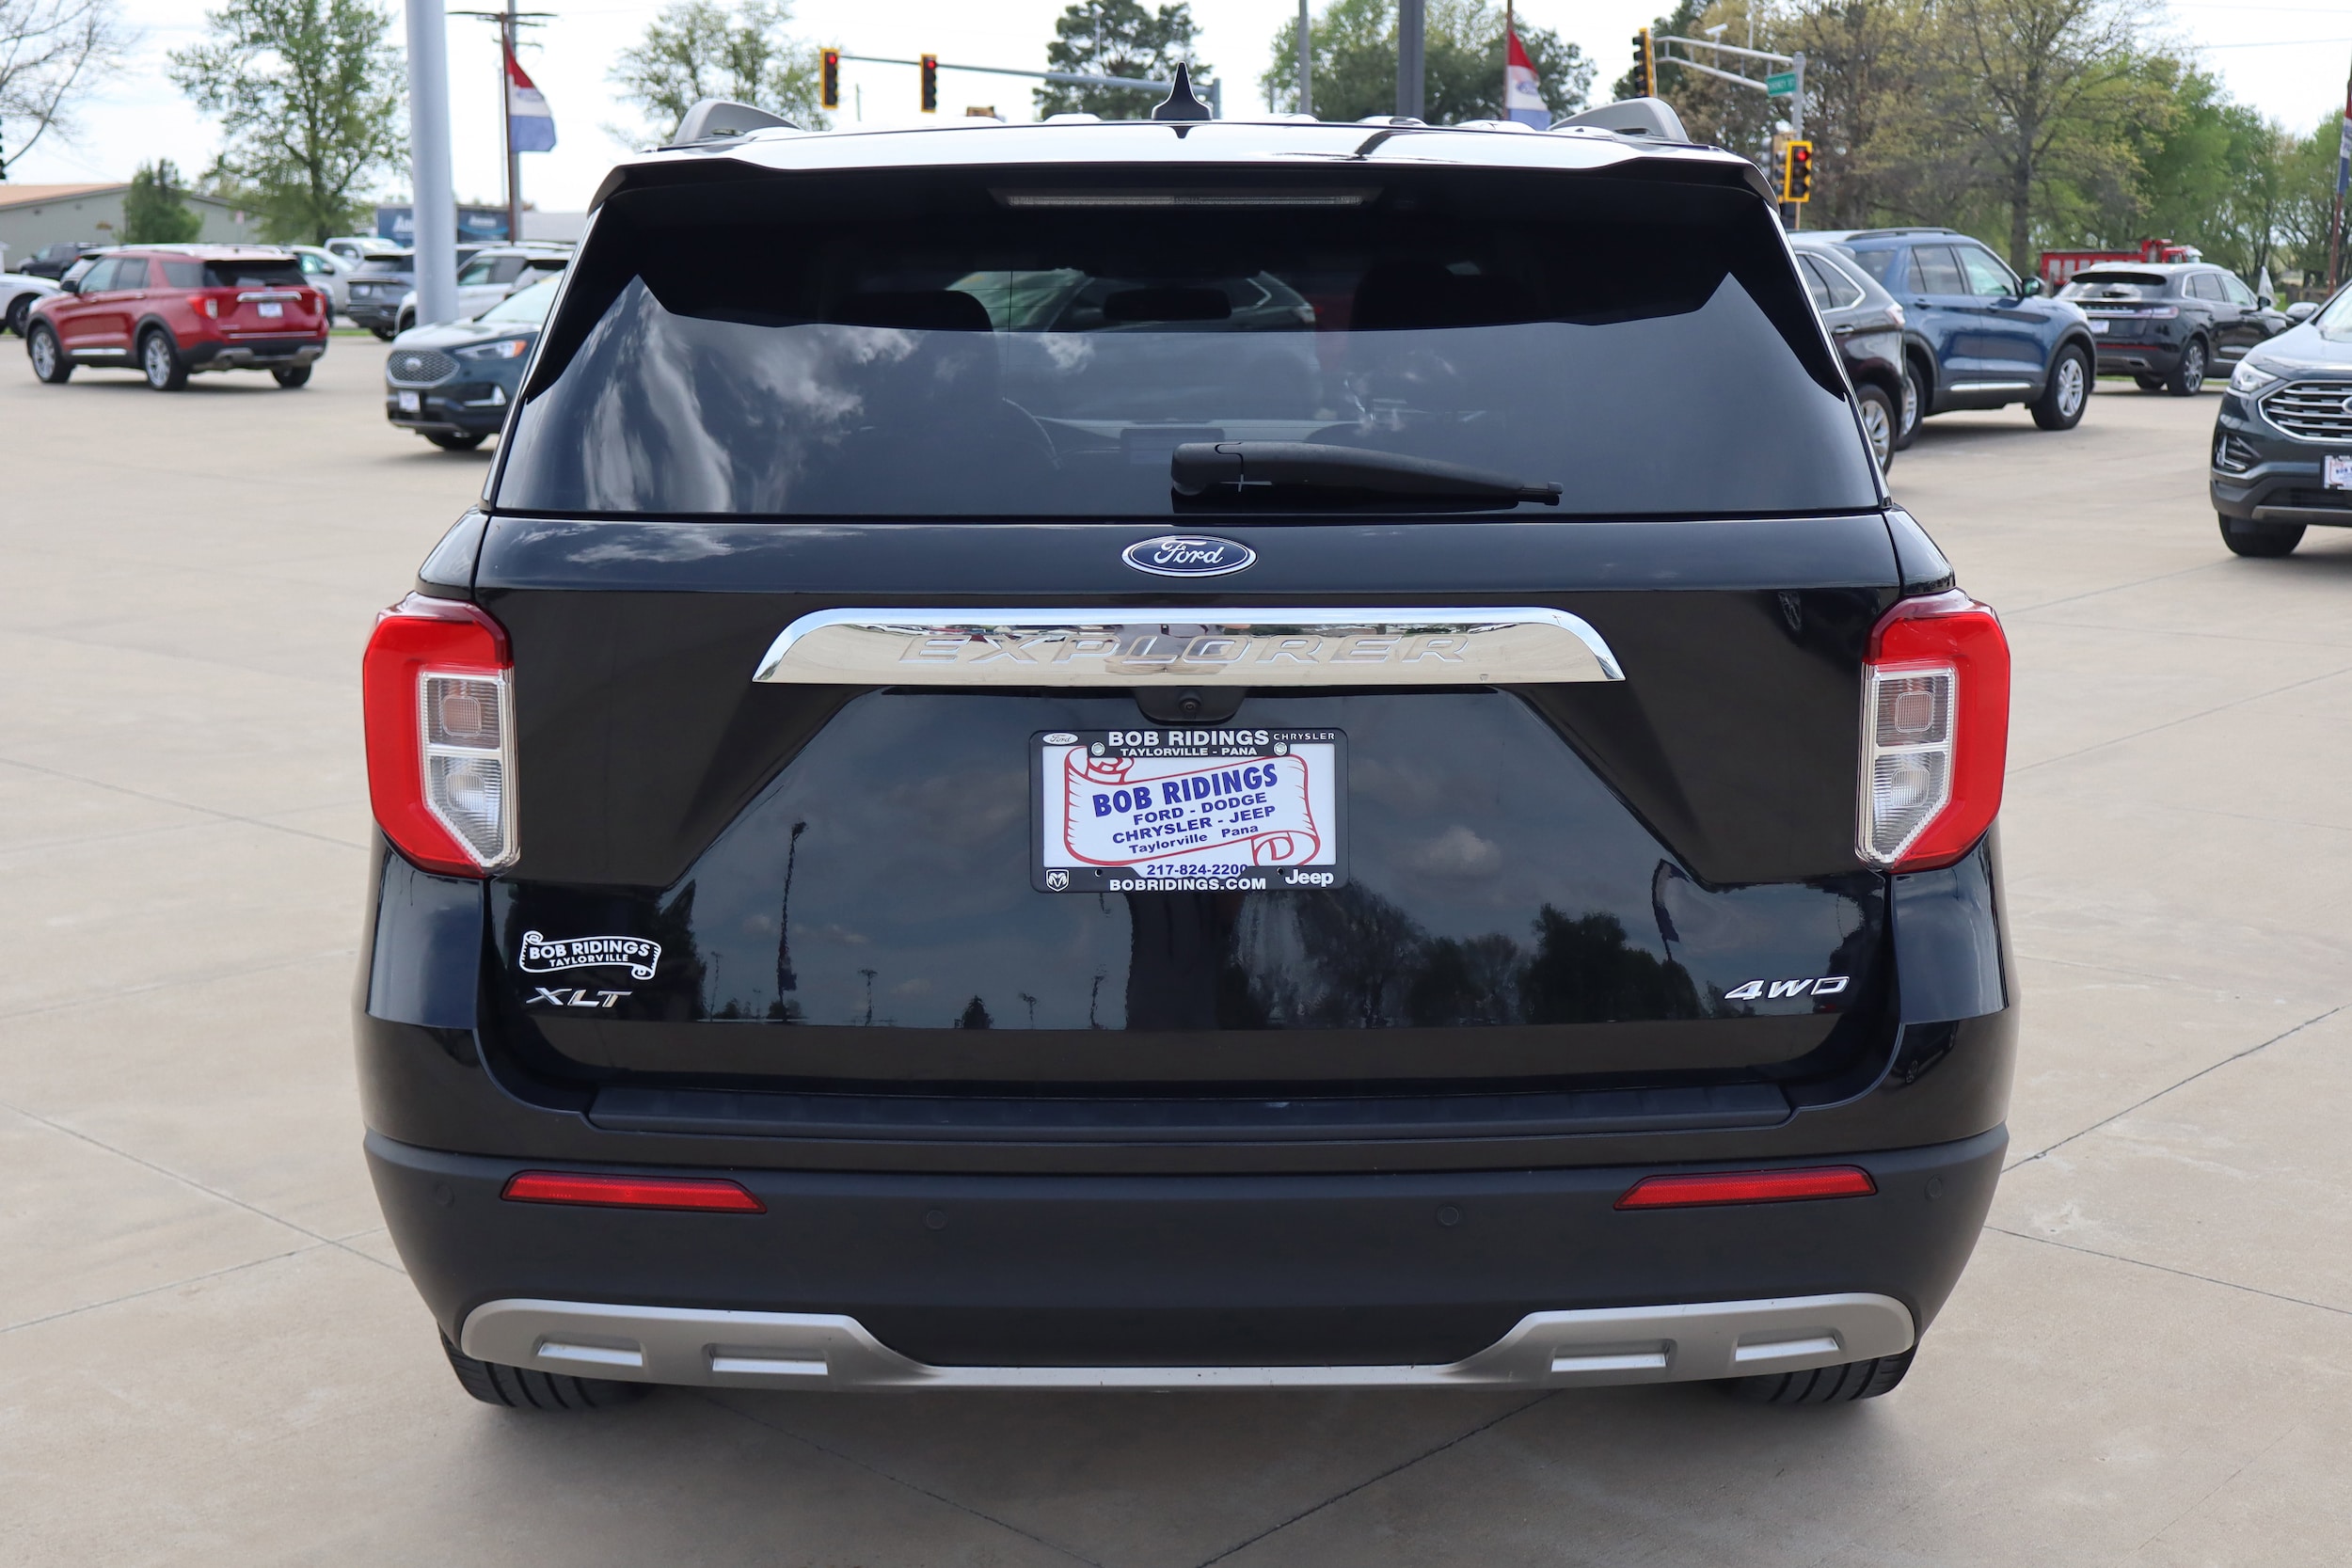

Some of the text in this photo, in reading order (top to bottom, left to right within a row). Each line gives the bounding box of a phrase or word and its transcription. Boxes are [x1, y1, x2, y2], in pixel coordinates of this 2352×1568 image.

[1153, 540, 1225, 564] Ford
[899, 634, 1469, 664] EXPLORER
[1108, 730, 1270, 746] BOB RIDINGS
[1120, 748, 1208, 756] TAYLORVILLE
[1092, 763, 1278, 817] BOB RIDINGS
[1133, 807, 1184, 825] FORD
[1201, 792, 1267, 814] DODGE
[1112, 816, 1213, 844] CHRYSLER
[1229, 806, 1276, 823] JEEP
[1129, 825, 1259, 854] Taylorville Pana
[1109, 878, 1266, 891] BOBRIDINGS.COM
[1284, 869, 1334, 887] Jeep
[529, 940, 651, 959] BOB RIDINGS
[548, 954, 629, 967] TAYLORVILLE
[526, 987, 633, 1008] XLT
[1724, 976, 1851, 1000] 4WD
